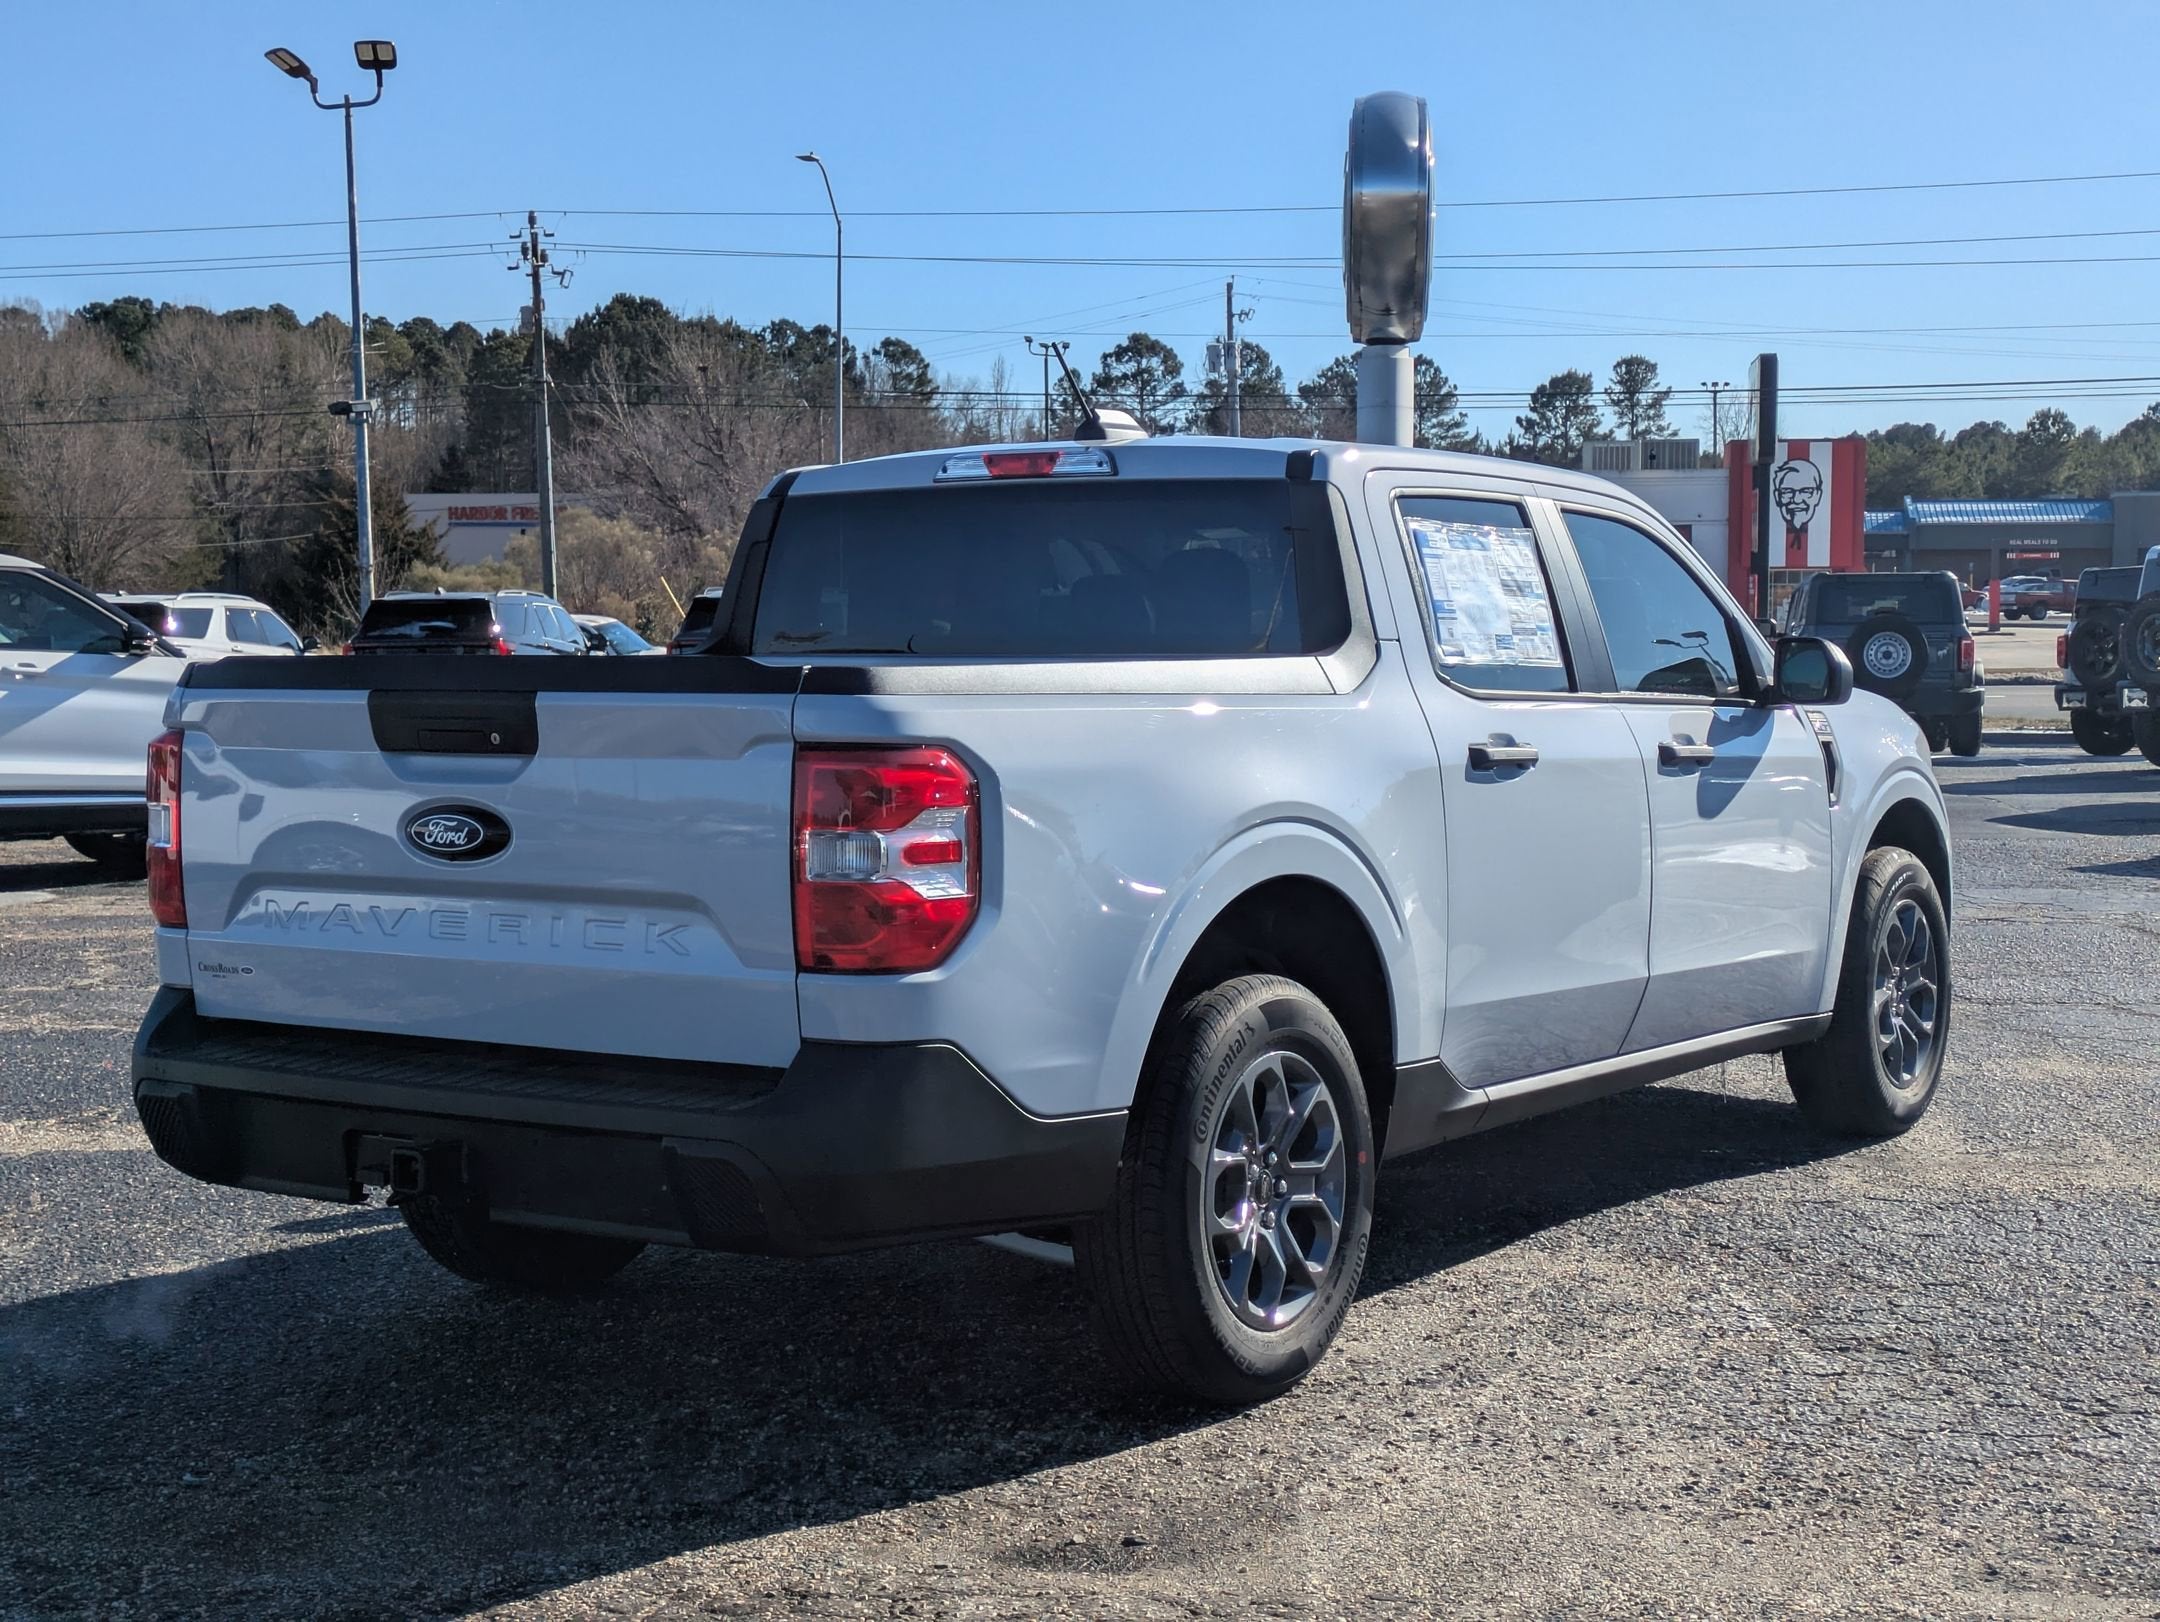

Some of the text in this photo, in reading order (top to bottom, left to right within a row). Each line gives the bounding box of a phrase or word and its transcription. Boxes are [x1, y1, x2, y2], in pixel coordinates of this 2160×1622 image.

[424, 819, 469, 845] Ford
[264, 898, 692, 957] MAVERICK
[1194, 1029, 1248, 1145] Continental
